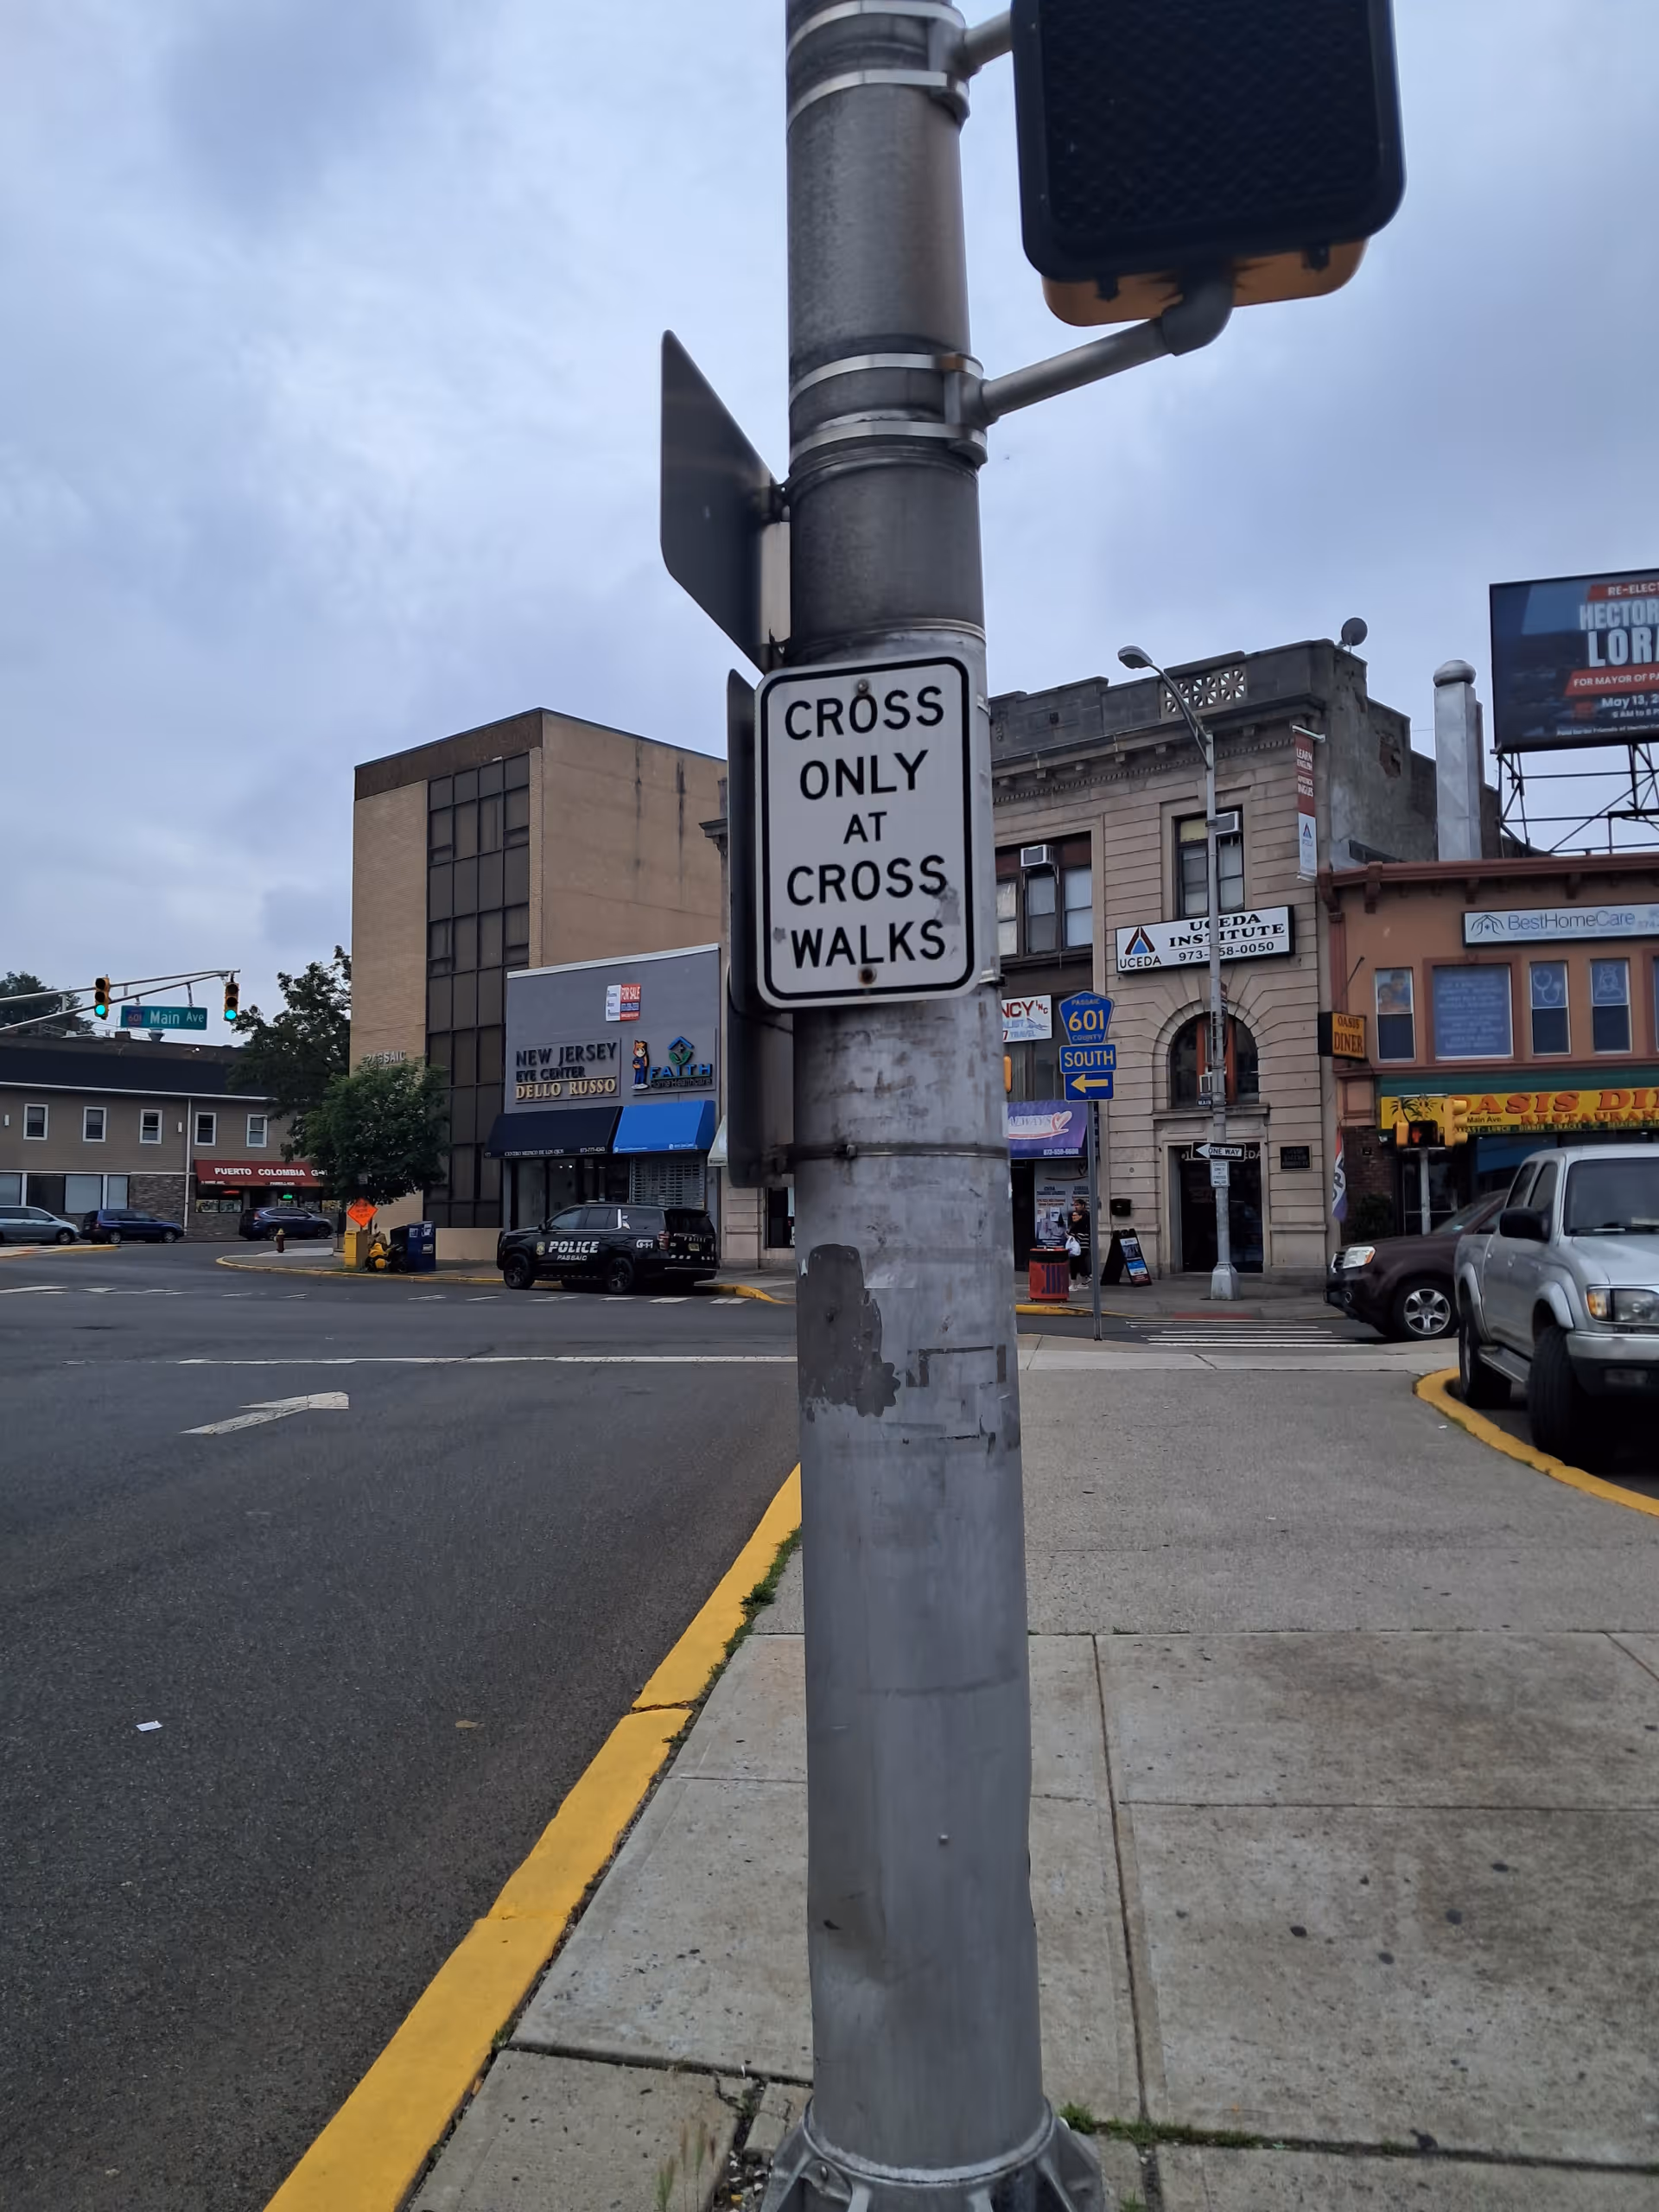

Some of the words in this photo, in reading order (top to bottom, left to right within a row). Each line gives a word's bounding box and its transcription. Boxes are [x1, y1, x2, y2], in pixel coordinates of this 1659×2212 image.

[1580, 599, 1659, 630] HECTOR
[1588, 626, 1659, 668] LOR
[1573, 678, 1593, 687] FOR
[1595, 675, 1631, 684] MAYOR
[1634, 673, 1647, 683] OF
[1601, 697, 1630, 709] May
[1631, 695, 1648, 706] 13,
[785, 686, 944, 741] CROSS
[800, 750, 928, 800] ONLY
[843, 812, 887, 844] AT
[787, 855, 947, 906] CROSS
[1508, 910, 1635, 931] BestHomeCare
[791, 919, 946, 969] WALKS
[1120, 956, 1161, 969] UCEDA
[630, 986, 640, 1000] SALE
[149, 1010, 180, 1025] Main
[186, 1011, 204, 1022] Ave
[1069, 1009, 1104, 1031] 601
[1337, 1015, 1360, 1029] OASIS
[1334, 1032, 1363, 1053] DINER
[516, 1048, 552, 1067] NEW
[558, 1042, 616, 1066] JERSEY
[1064, 1050, 1114, 1067] SOUTH
[516, 1070, 537, 1083] EYE
[540, 1065, 586, 1081] CENTER
[650, 1063, 713, 1080] FAITH
[516, 1083, 562, 1099] DELLO
[569, 1078, 616, 1095] RUSSO
[1597, 1087, 1659, 1111] DI
[214, 1167, 252, 1176] PUERTO
[257, 1168, 306, 1177] COLOMBIA
[548, 1241, 600, 1254] POLICE
